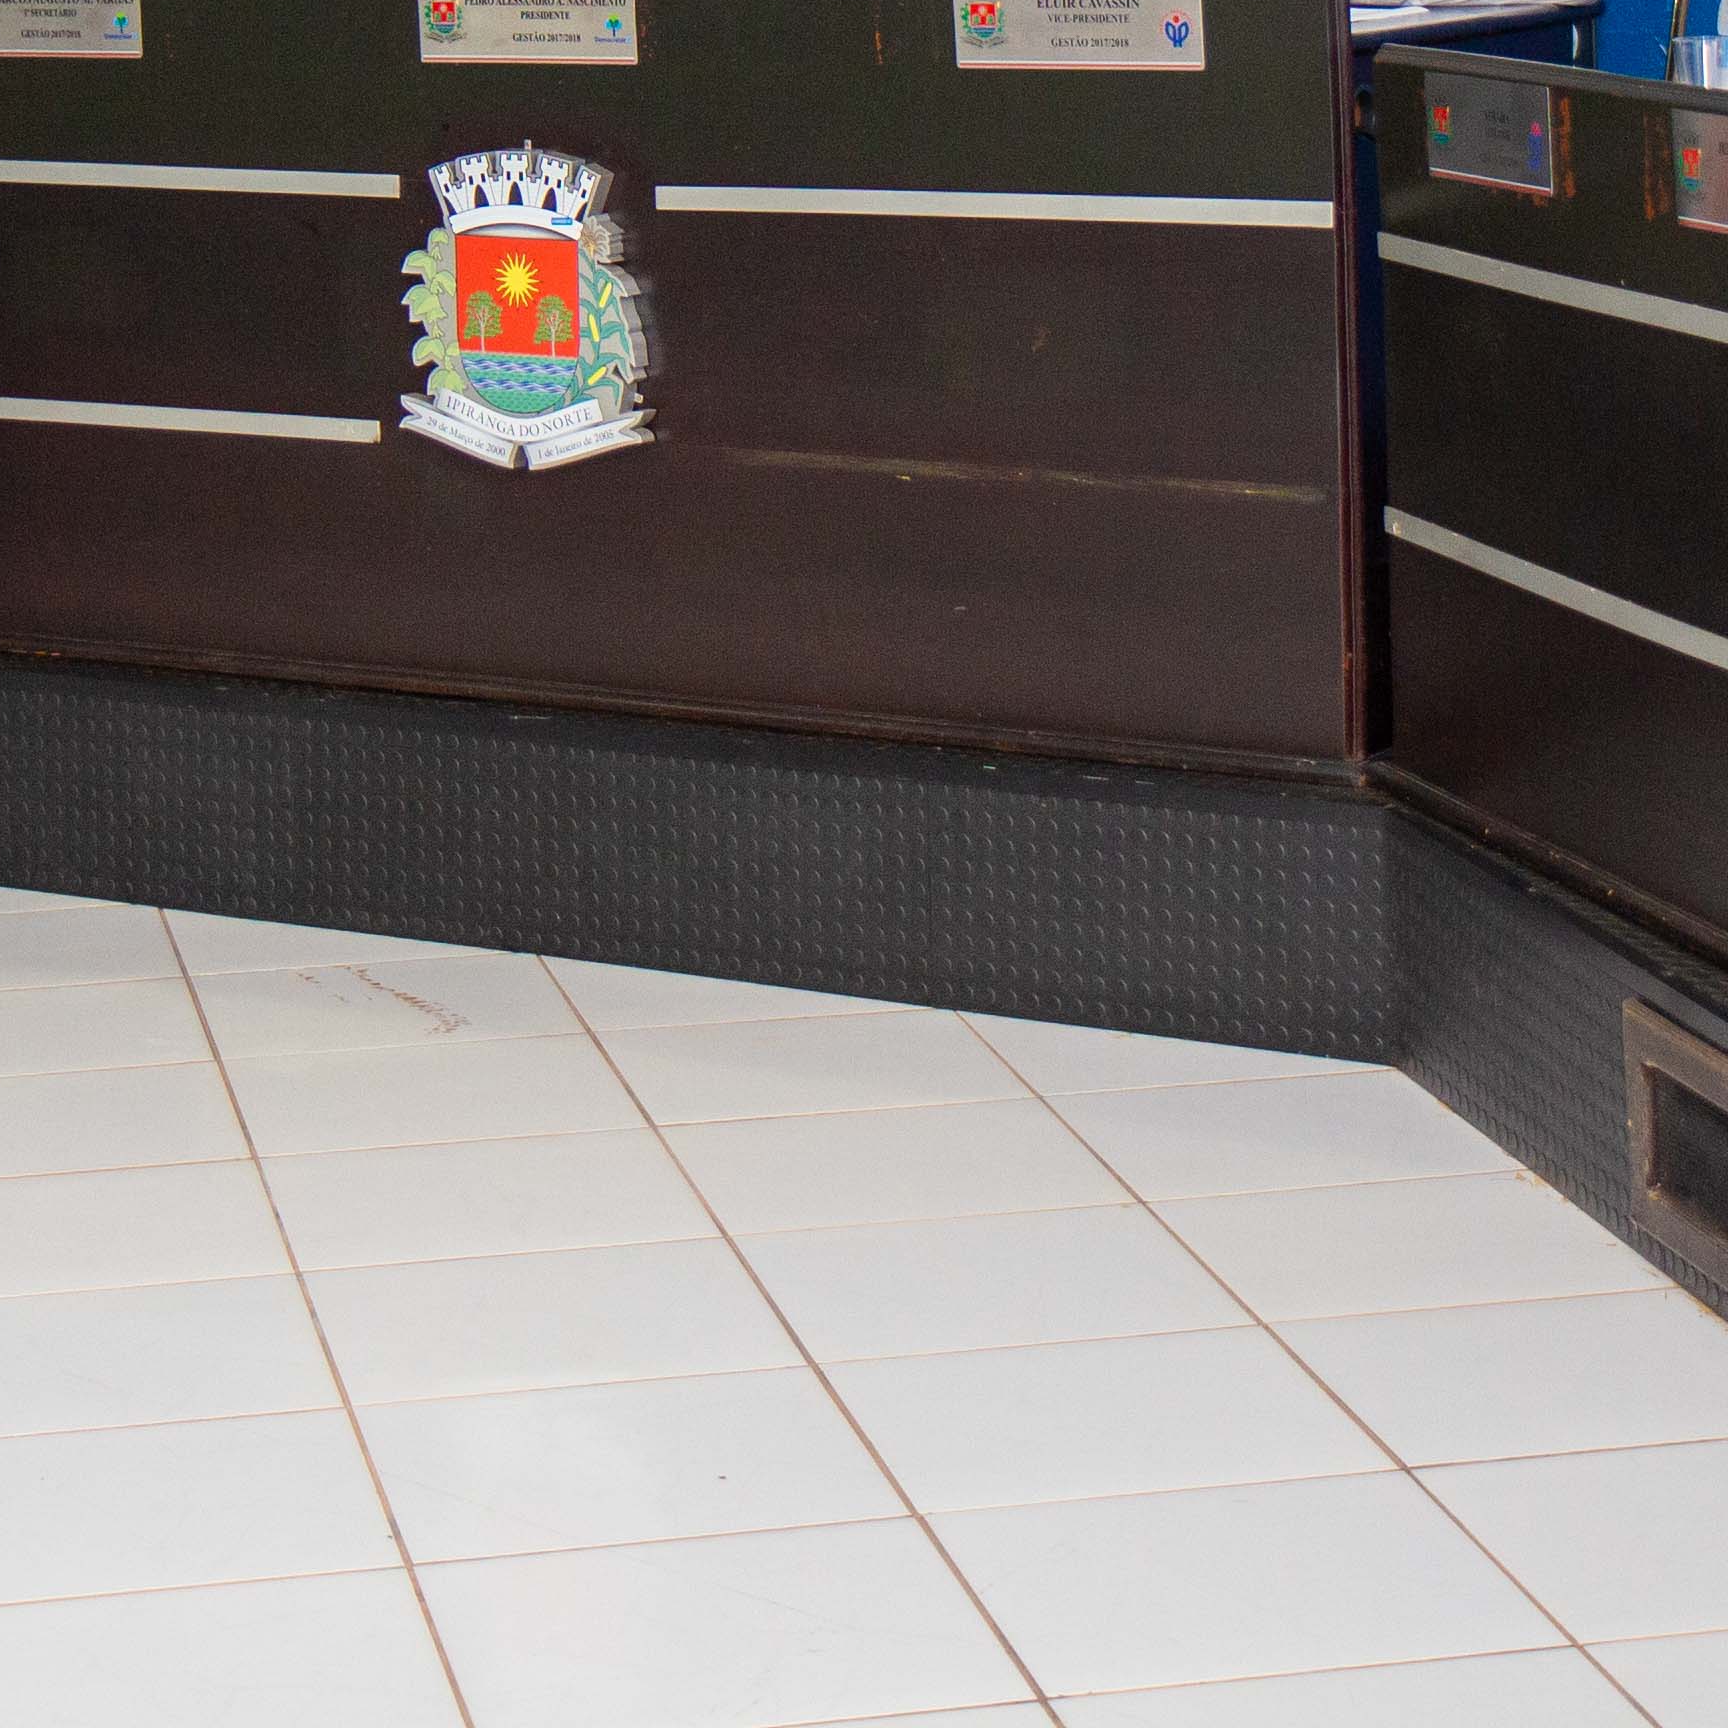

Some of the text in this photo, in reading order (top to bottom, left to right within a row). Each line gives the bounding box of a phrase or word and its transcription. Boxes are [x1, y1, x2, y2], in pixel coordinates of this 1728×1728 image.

[520, 11, 570, 20] PRESIDENTE
[1047, 14, 1130, 24] VICE-PRESIDENTE
[512, 30, 546, 43] GESTÃO
[547, 33, 581, 43] 2017/2018
[1051, 35, 1130, 48] GESTÃO 2017/2018
[446, 395, 593, 437] IPIRANGA DO NORTE
